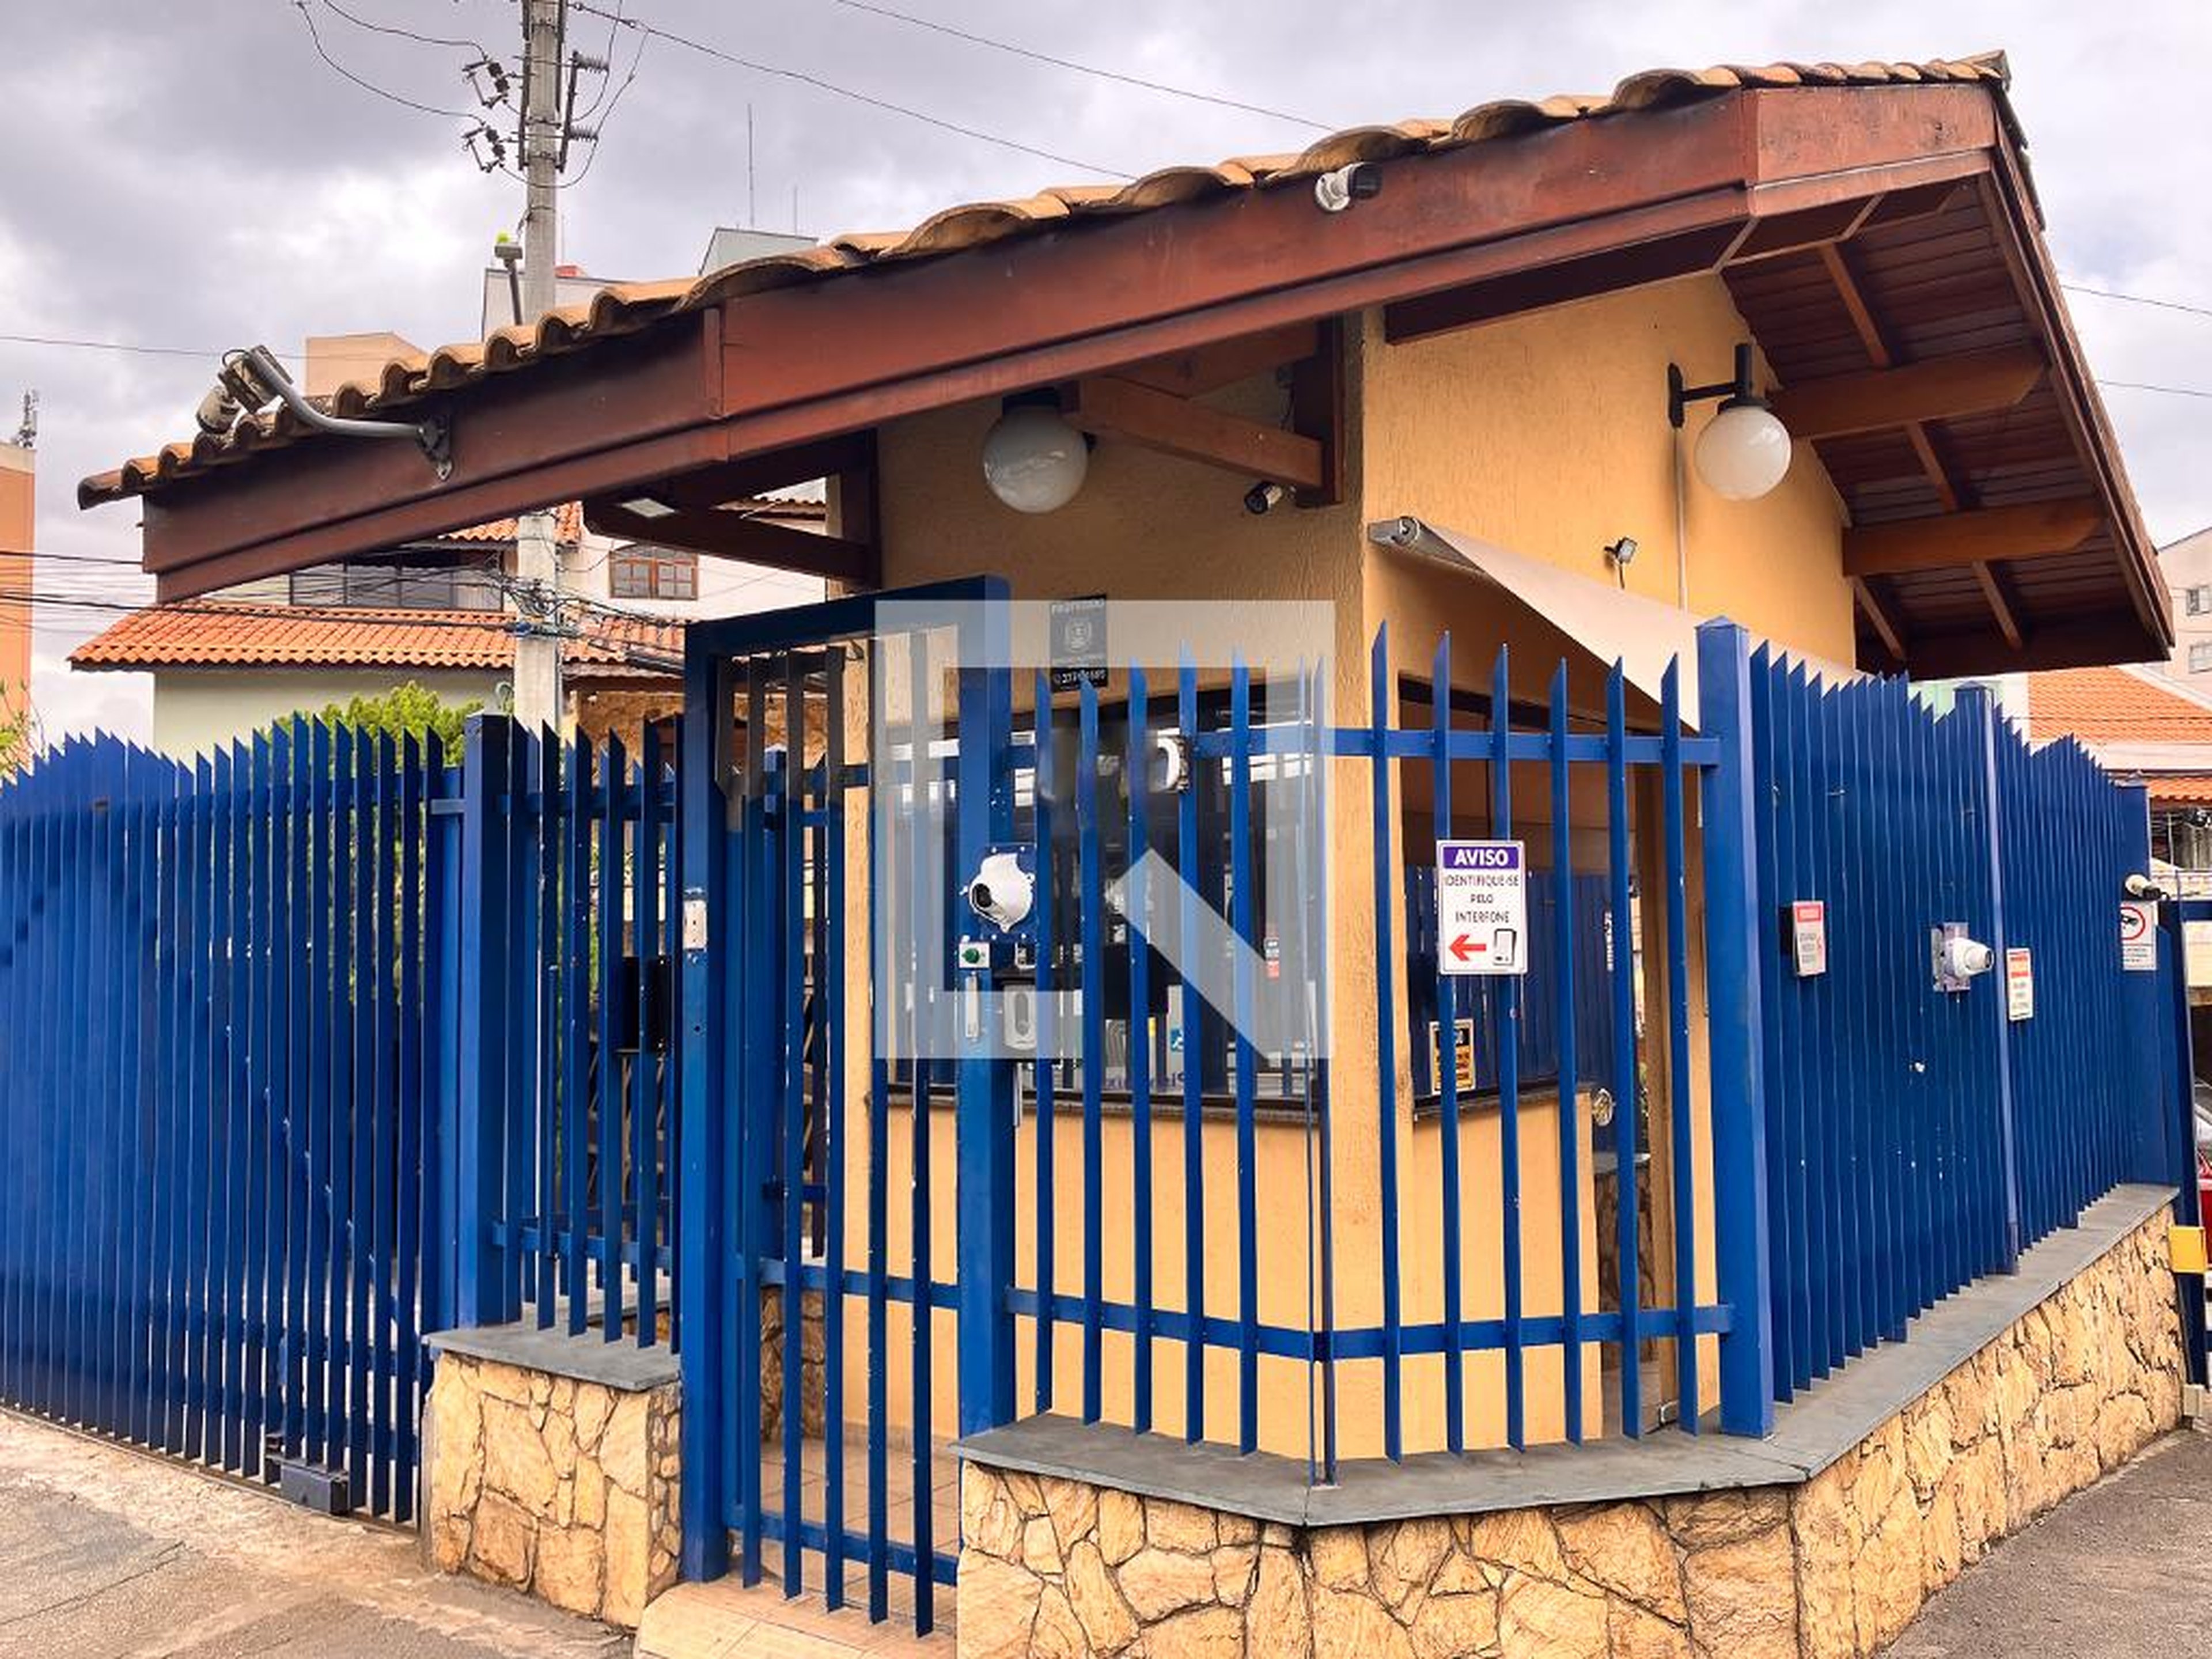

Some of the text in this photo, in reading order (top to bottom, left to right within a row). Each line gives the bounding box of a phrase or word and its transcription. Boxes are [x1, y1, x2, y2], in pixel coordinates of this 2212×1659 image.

[1453, 849, 1509, 867] AVISO
[1444, 874, 1520, 888] IDENTIFIQUE-SE
[1469, 893, 1494, 904] PELO
[1455, 911, 1510, 923] INTERFONE
